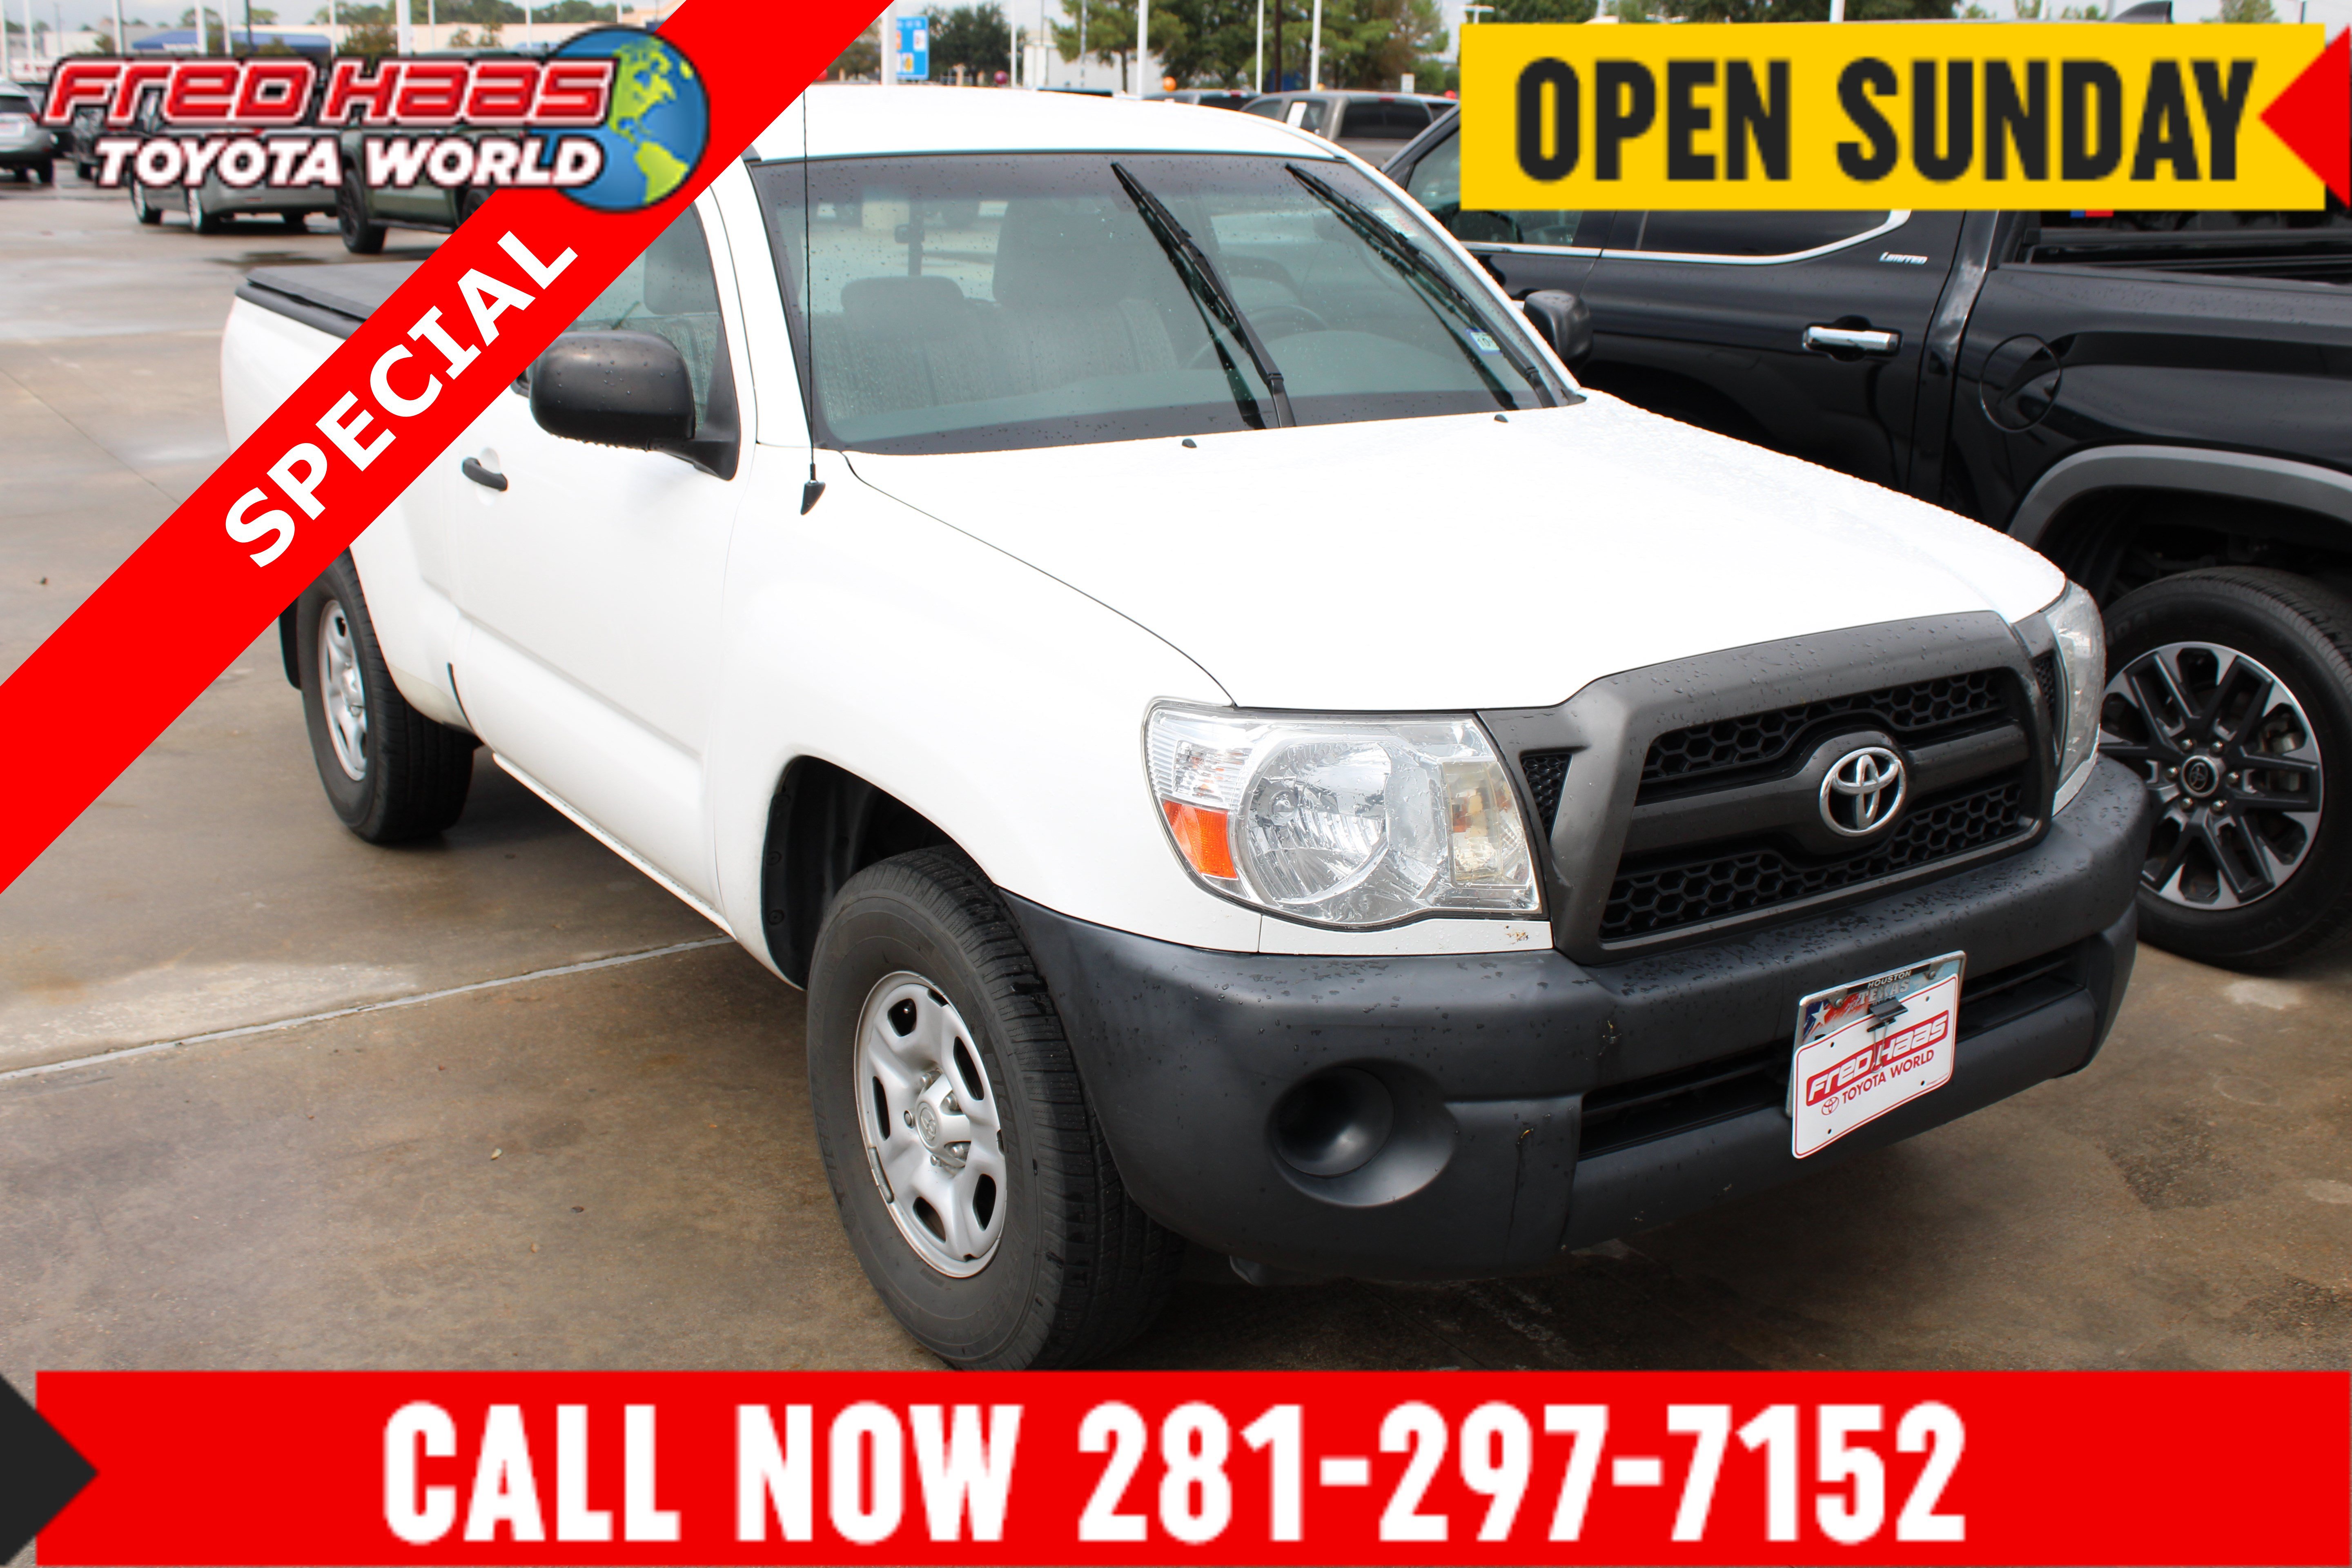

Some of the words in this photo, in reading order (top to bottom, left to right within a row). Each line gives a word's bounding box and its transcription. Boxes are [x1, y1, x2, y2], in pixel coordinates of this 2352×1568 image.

[1859, 978, 1910, 1004] TEXAS
[1868, 970, 1911, 988] HOUSTON
[1842, 1071, 1886, 1104] TOYOTA
[1890, 1049, 1934, 1078] WORLD
